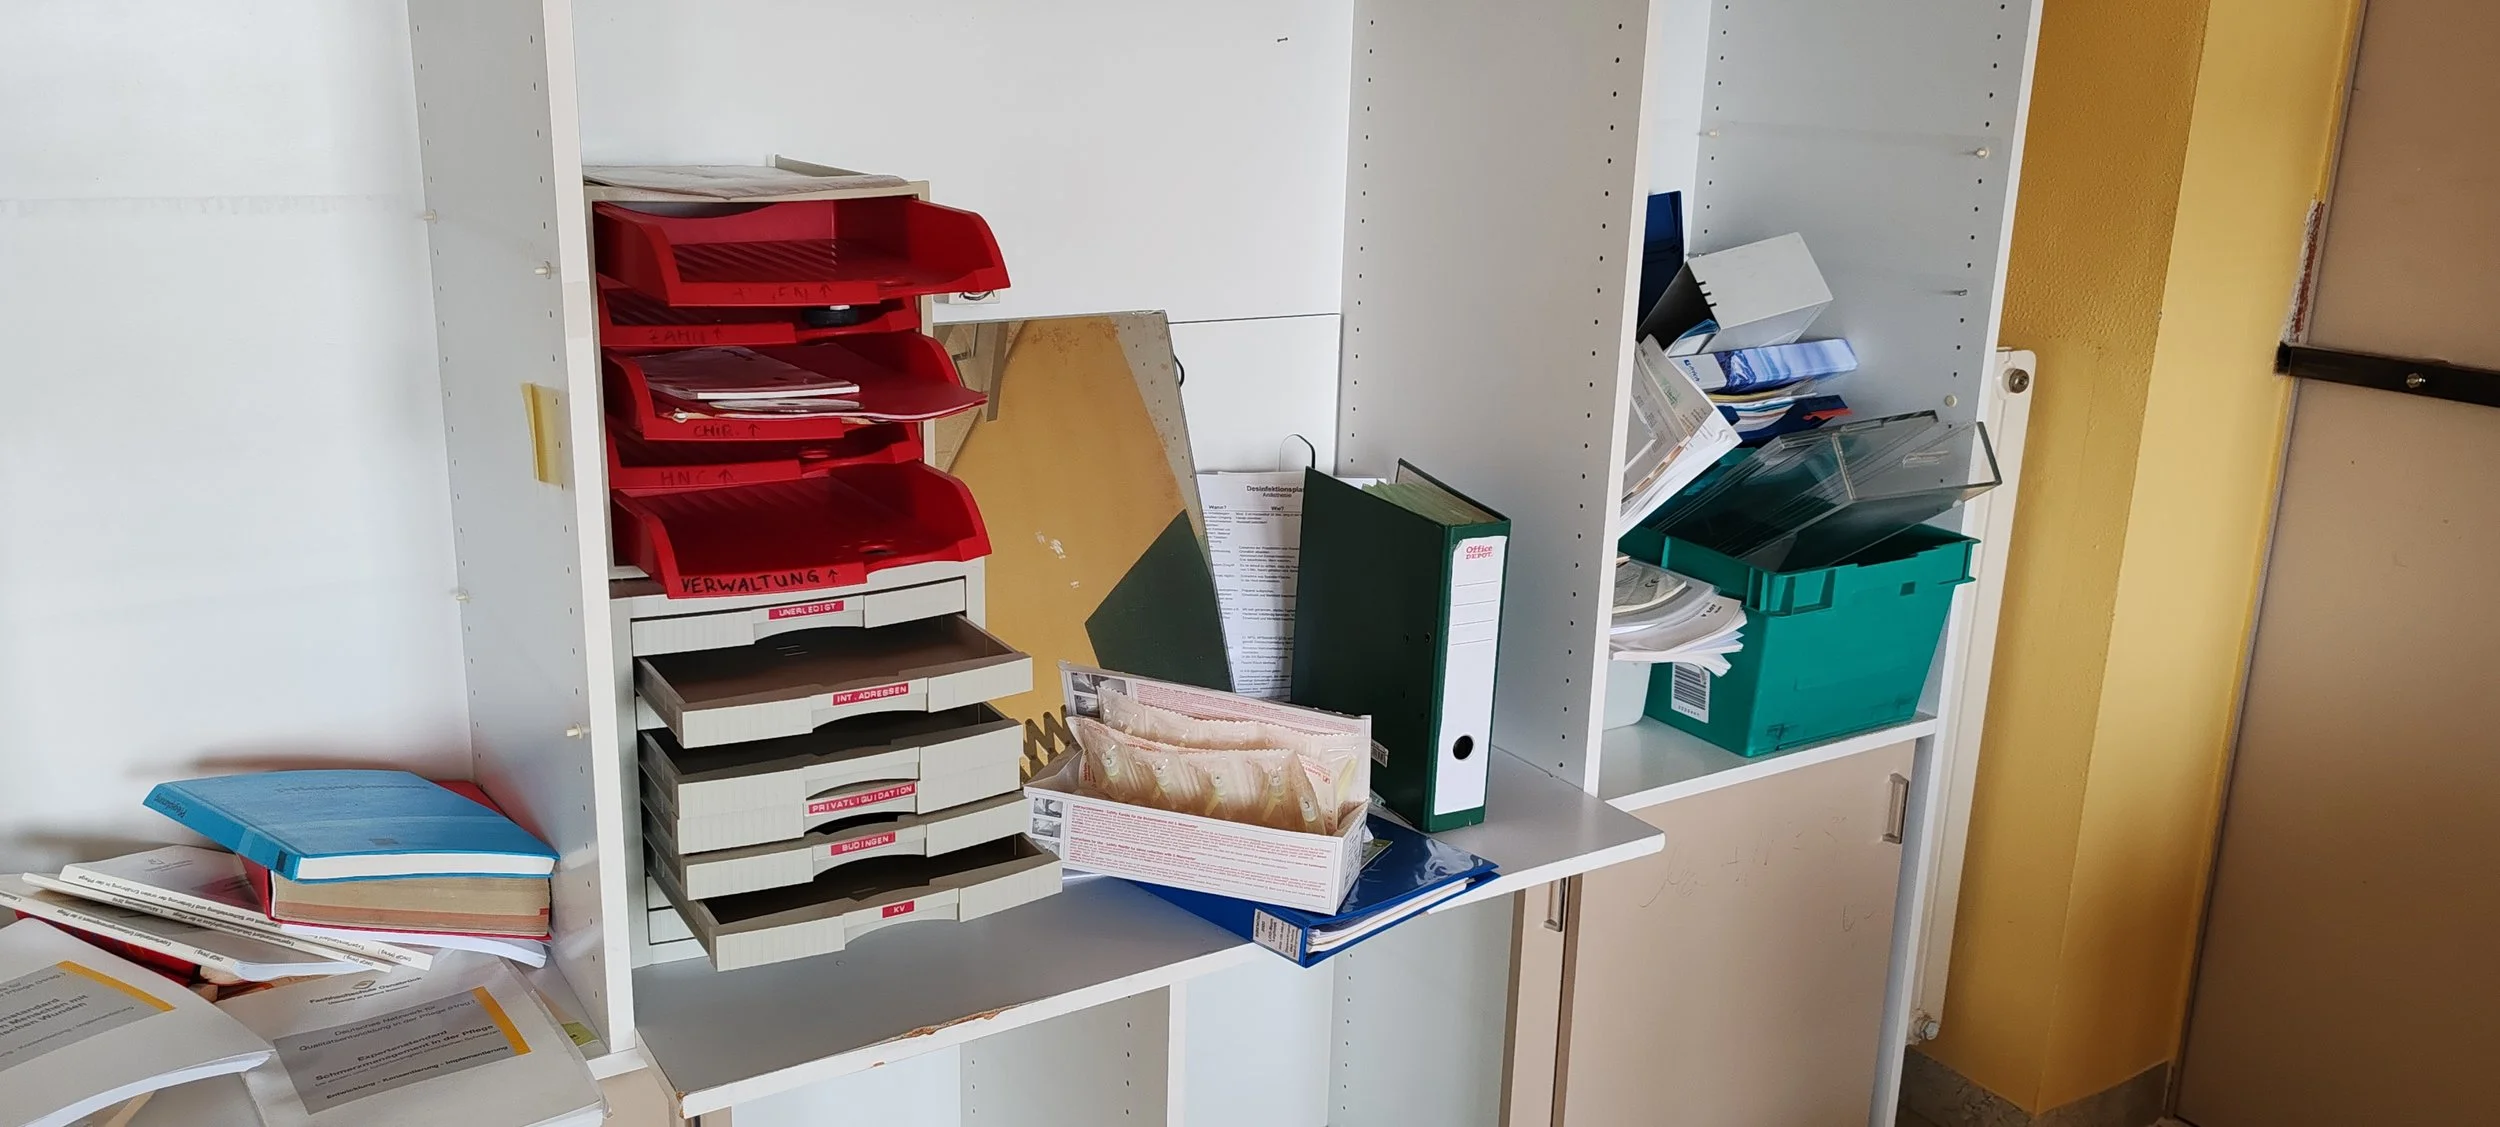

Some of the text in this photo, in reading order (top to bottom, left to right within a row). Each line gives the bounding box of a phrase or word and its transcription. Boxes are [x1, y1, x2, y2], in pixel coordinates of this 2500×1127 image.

[1466, 545, 1493, 554] Office
[681, 570, 820, 594] VERWALTUNG
[778, 603, 836, 617] UNERLEDIGT
[812, 785, 913, 813] PRIVATLIQUIDATION
[893, 905, 907, 913] KV
[316, 1040, 431, 1081] Schmerzmanagement
[443, 1031, 461, 1042] der
[462, 1024, 494, 1038] Pflege
[358, 1030, 448, 1062] Expertenstandard
